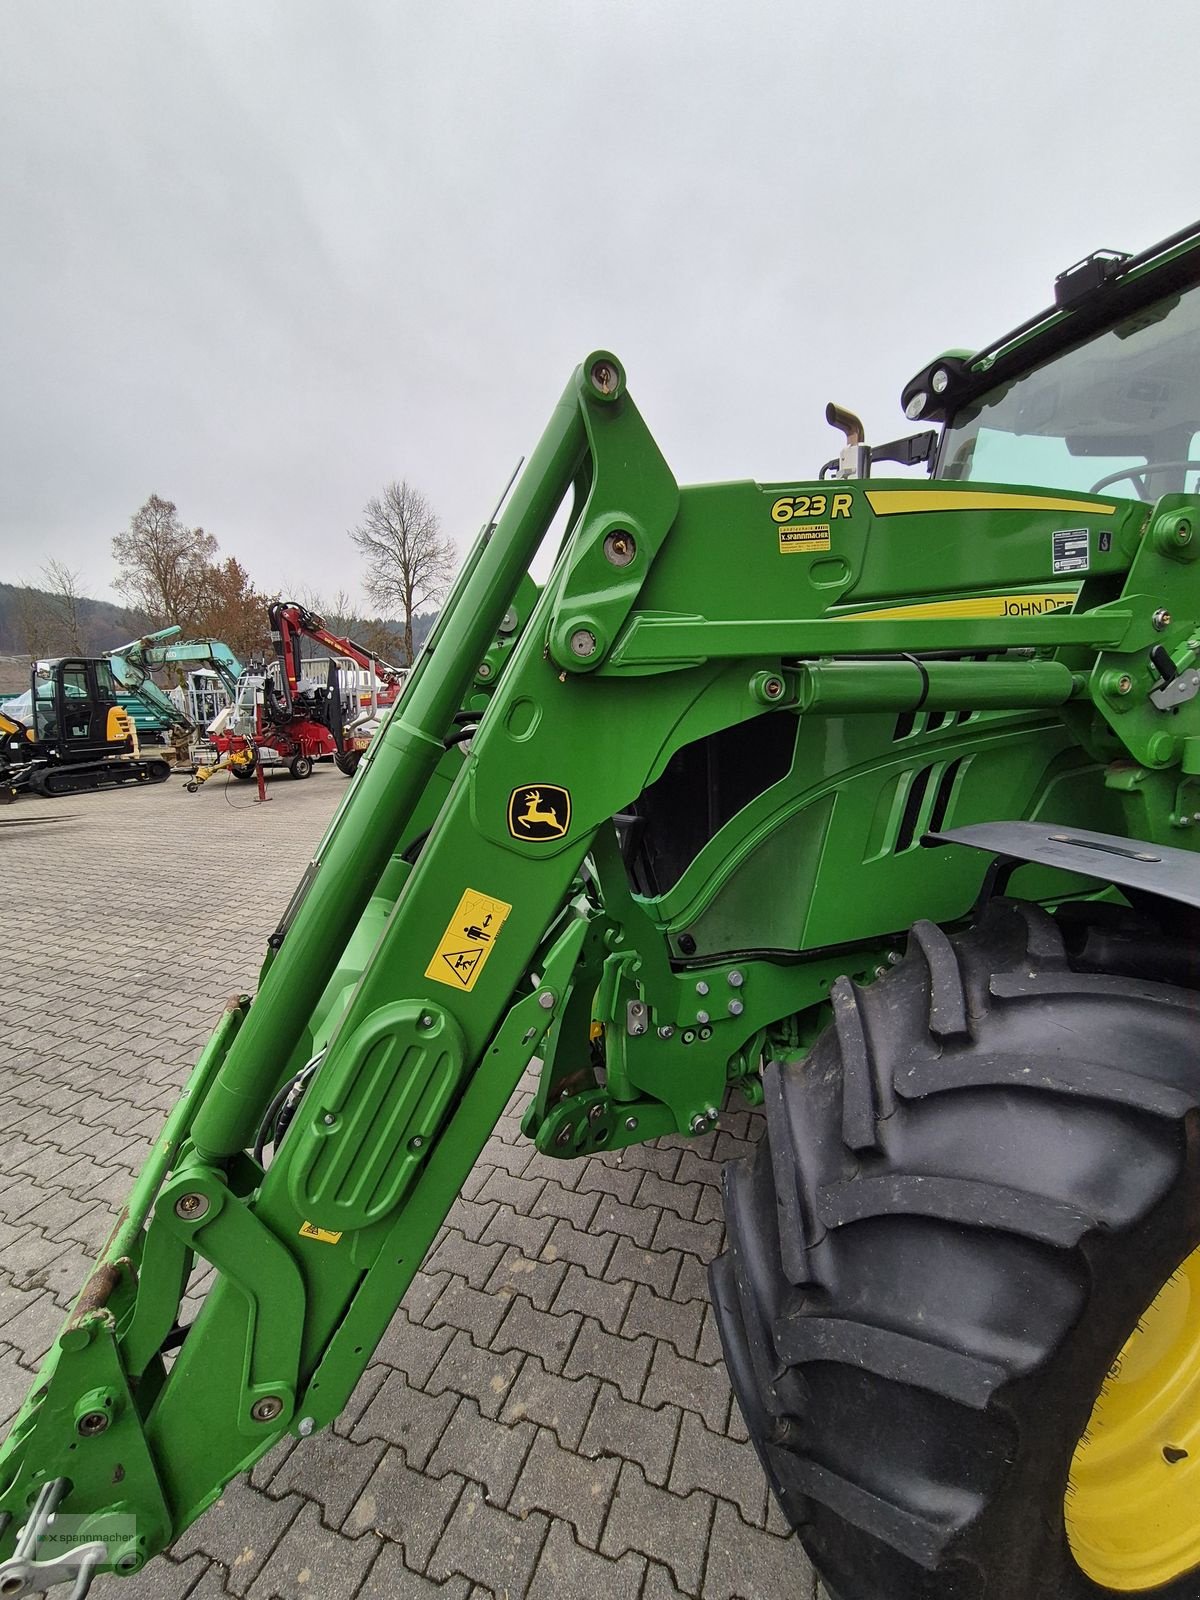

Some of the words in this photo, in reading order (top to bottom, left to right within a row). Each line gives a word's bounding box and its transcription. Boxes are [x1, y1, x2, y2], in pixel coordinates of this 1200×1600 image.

[770, 494, 827, 523] 623
[831, 493, 853, 519] R
[1000, 600, 1042, 617] JOHN
